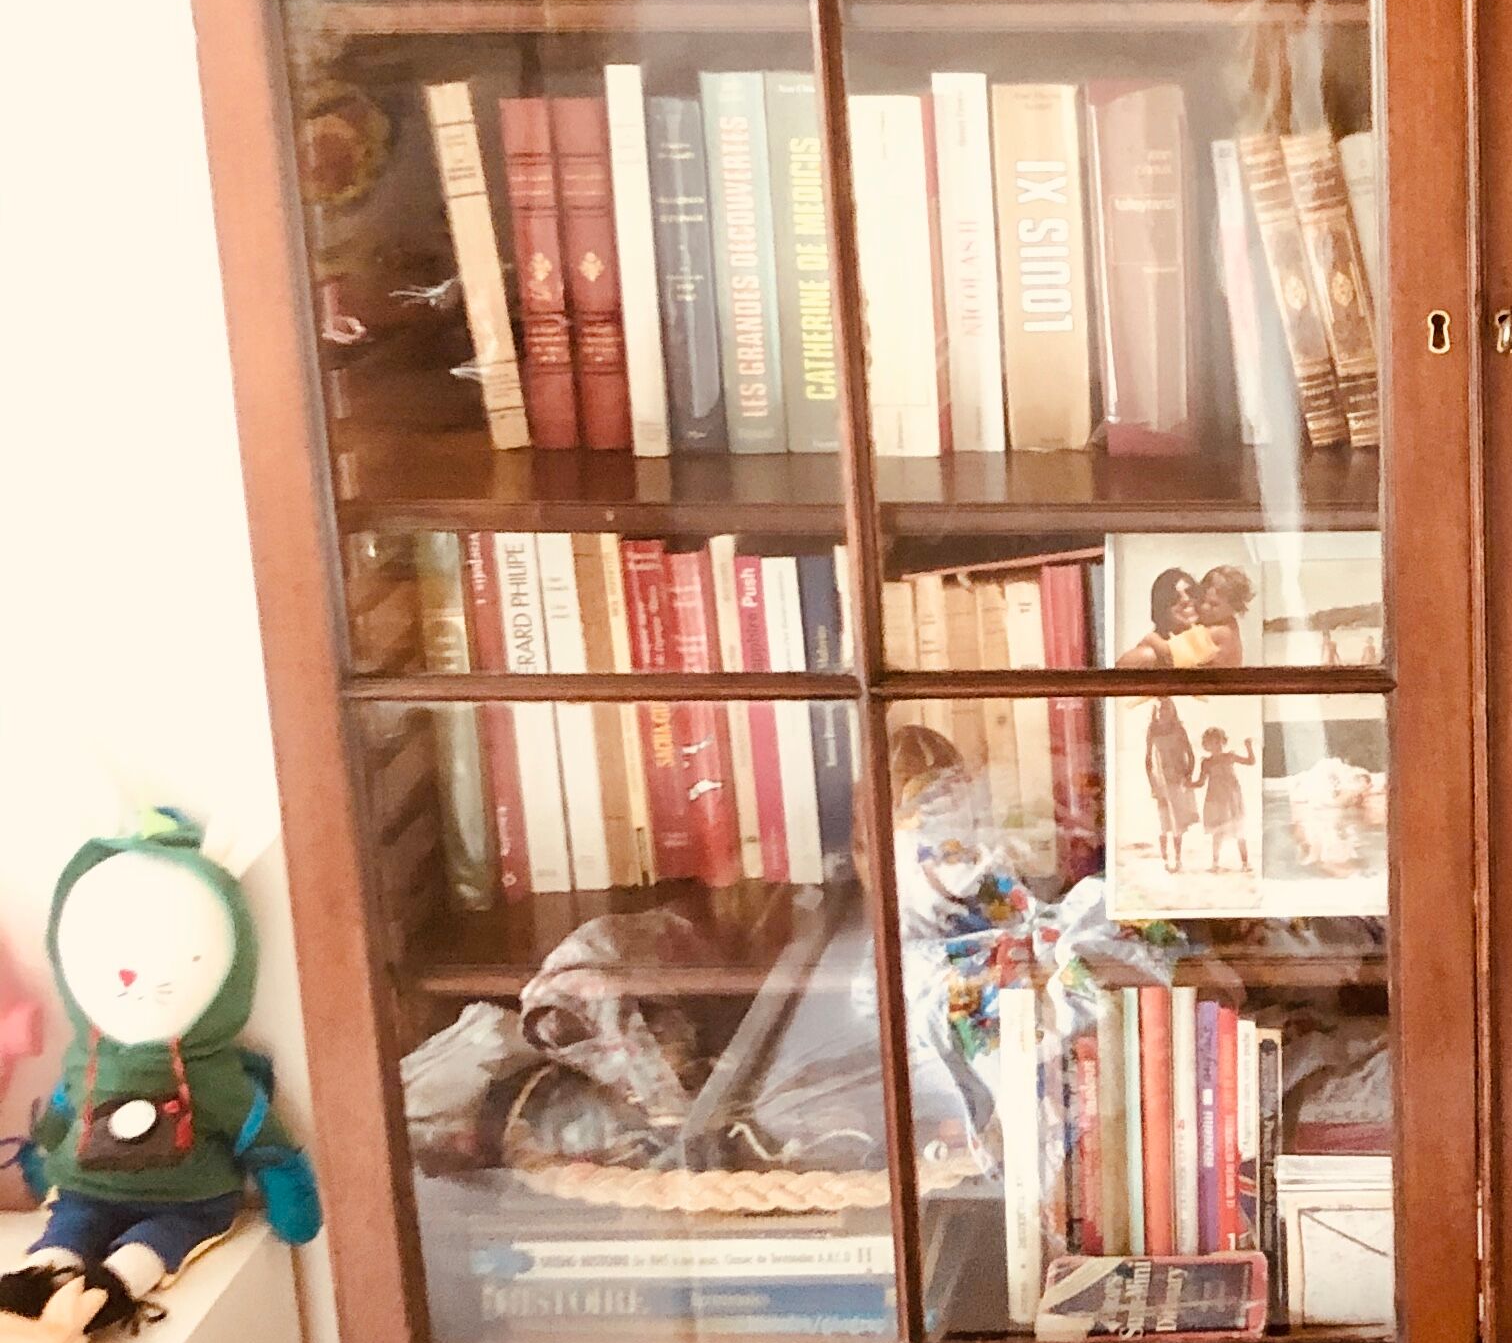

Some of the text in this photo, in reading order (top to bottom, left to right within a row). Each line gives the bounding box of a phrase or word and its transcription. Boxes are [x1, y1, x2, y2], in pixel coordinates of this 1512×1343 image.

[1016, 161, 1067, 204] XI
[796, 243, 829, 271] DE
[957, 220, 984, 337] NICOLAS II
[1017, 217, 1074, 332] LOUIS
[732, 274, 766, 375] GRANDES
[799, 279, 837, 400] CATHERINE
[741, 382, 768, 418] LES
[504, 543, 530, 608] PHILIPE
[740, 566, 758, 608] Push
